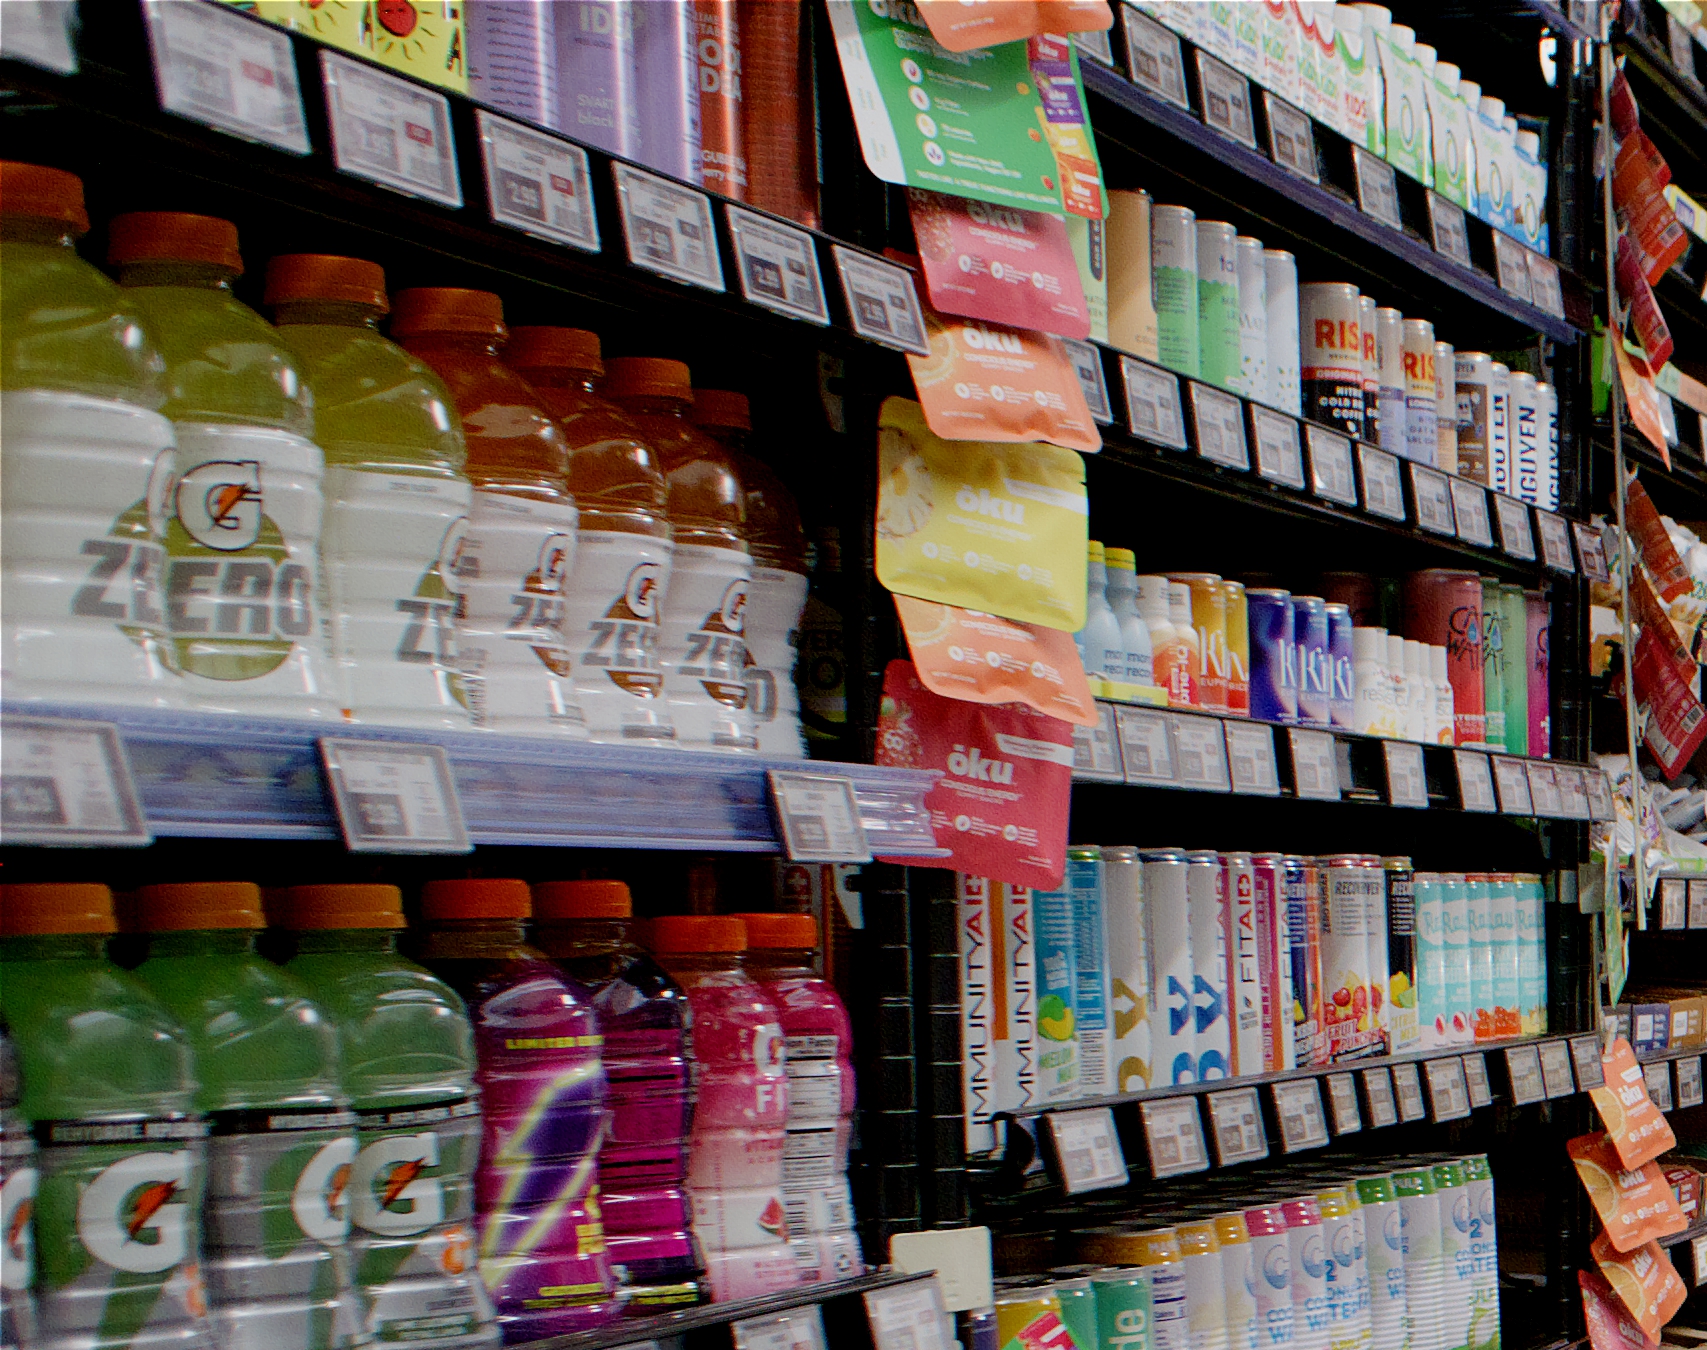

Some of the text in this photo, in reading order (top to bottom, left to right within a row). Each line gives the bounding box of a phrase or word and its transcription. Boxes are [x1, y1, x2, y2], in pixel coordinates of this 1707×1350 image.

[955, 485, 1026, 528] öku
[948, 743, 1015, 787] öku
[1237, 873, 1256, 983] FITAID
